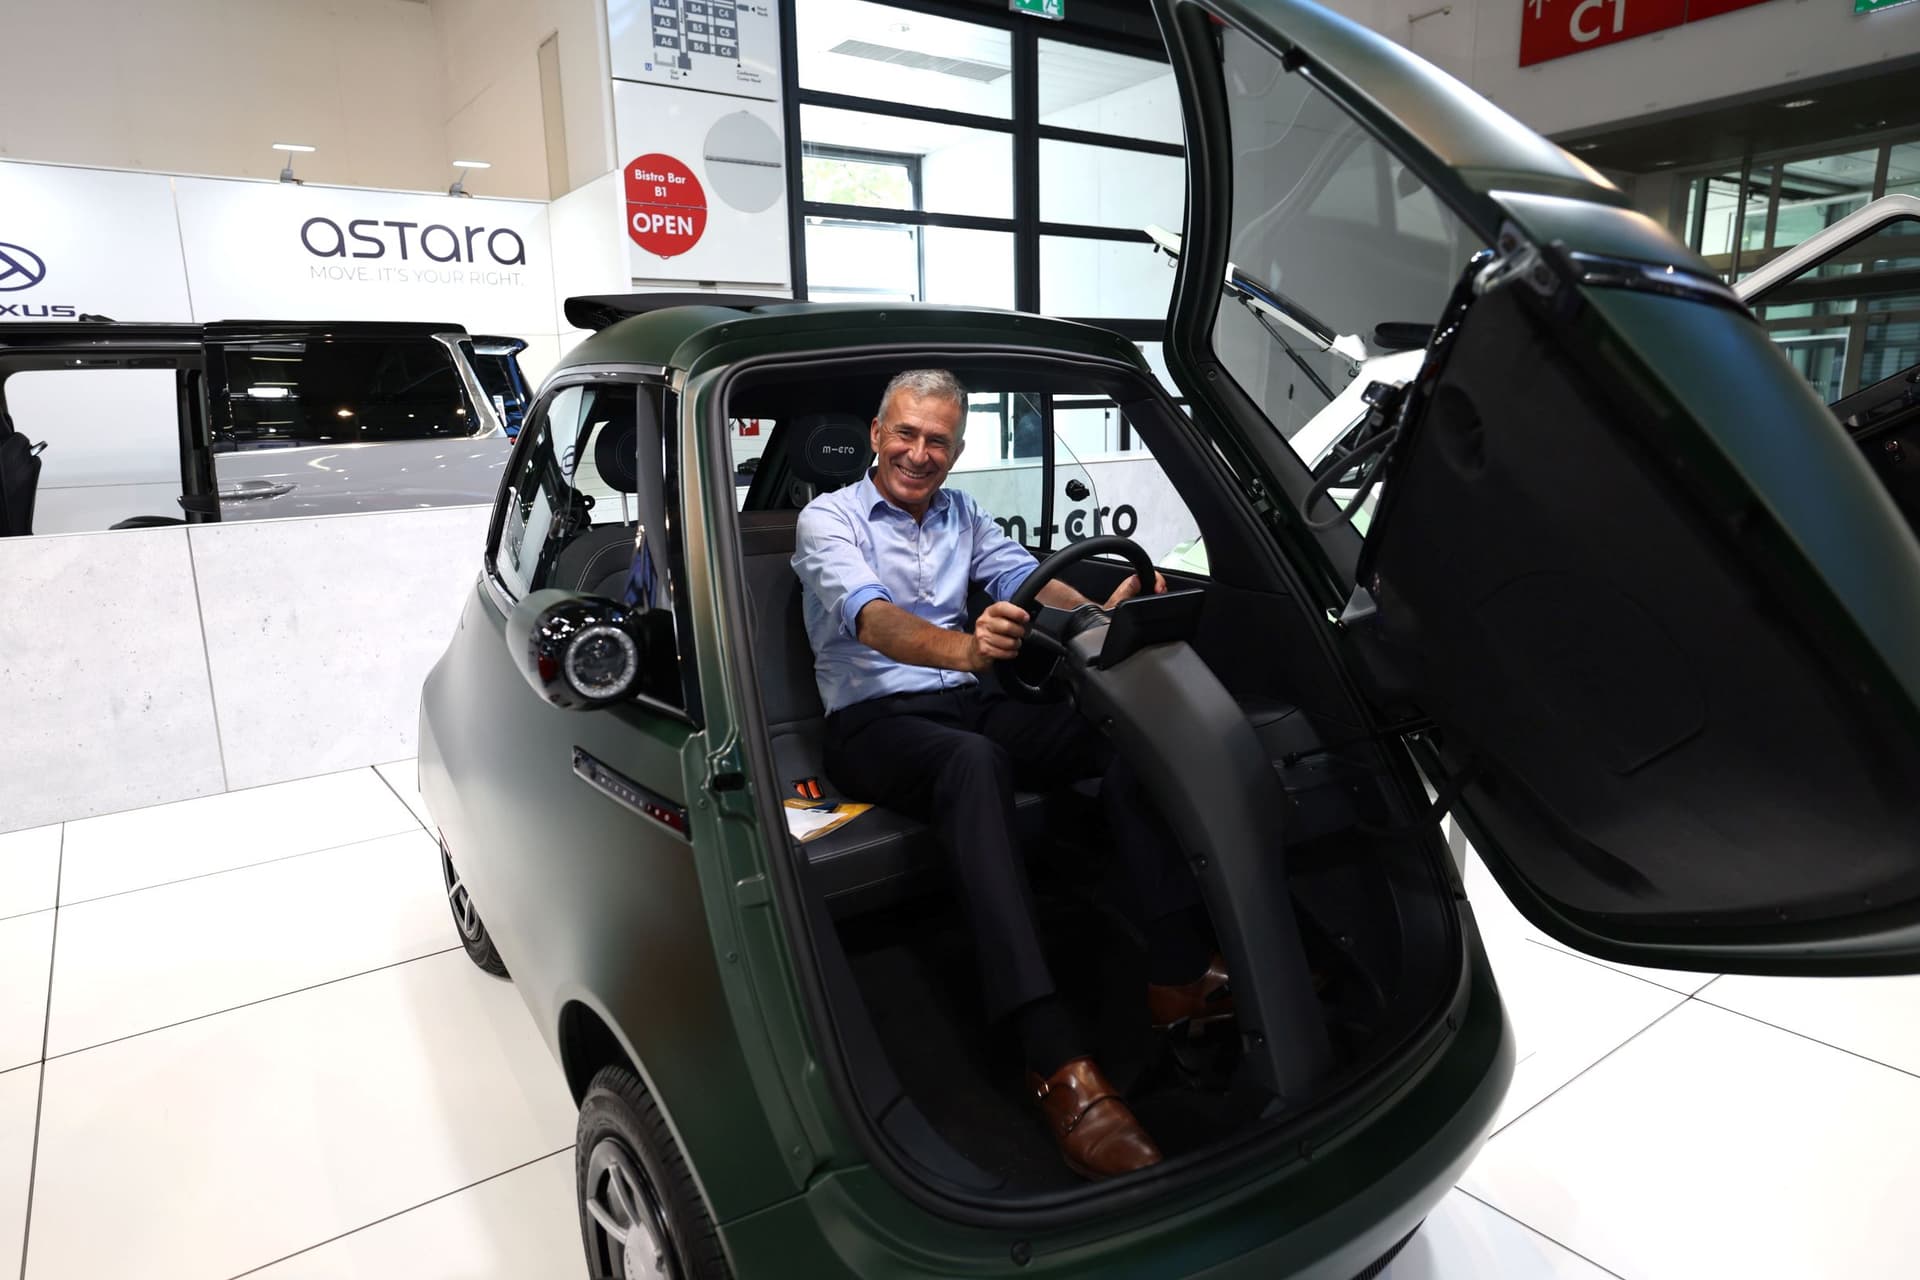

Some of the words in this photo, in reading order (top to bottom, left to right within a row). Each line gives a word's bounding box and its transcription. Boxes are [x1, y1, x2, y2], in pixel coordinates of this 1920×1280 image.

[691, 4, 702, 13] B4
[719, 9, 729, 18] C4
[660, 17, 671, 27] A5
[1569, 0, 1626, 42] C1
[692, 23, 703, 32] B5
[720, 28, 730, 37] C5
[661, 37, 672, 46] A6
[694, 42, 704, 52] B6
[721, 47, 731, 56] C6
[634, 169, 665, 182] Bistro
[667, 172, 686, 184] Bar
[655, 186, 667, 197] B1
[632, 212, 694, 236] OPEN
[378, 267, 409, 281] IT'S
[413, 269, 464, 284] YOUR
[470, 271, 525, 286] RIGHT.
